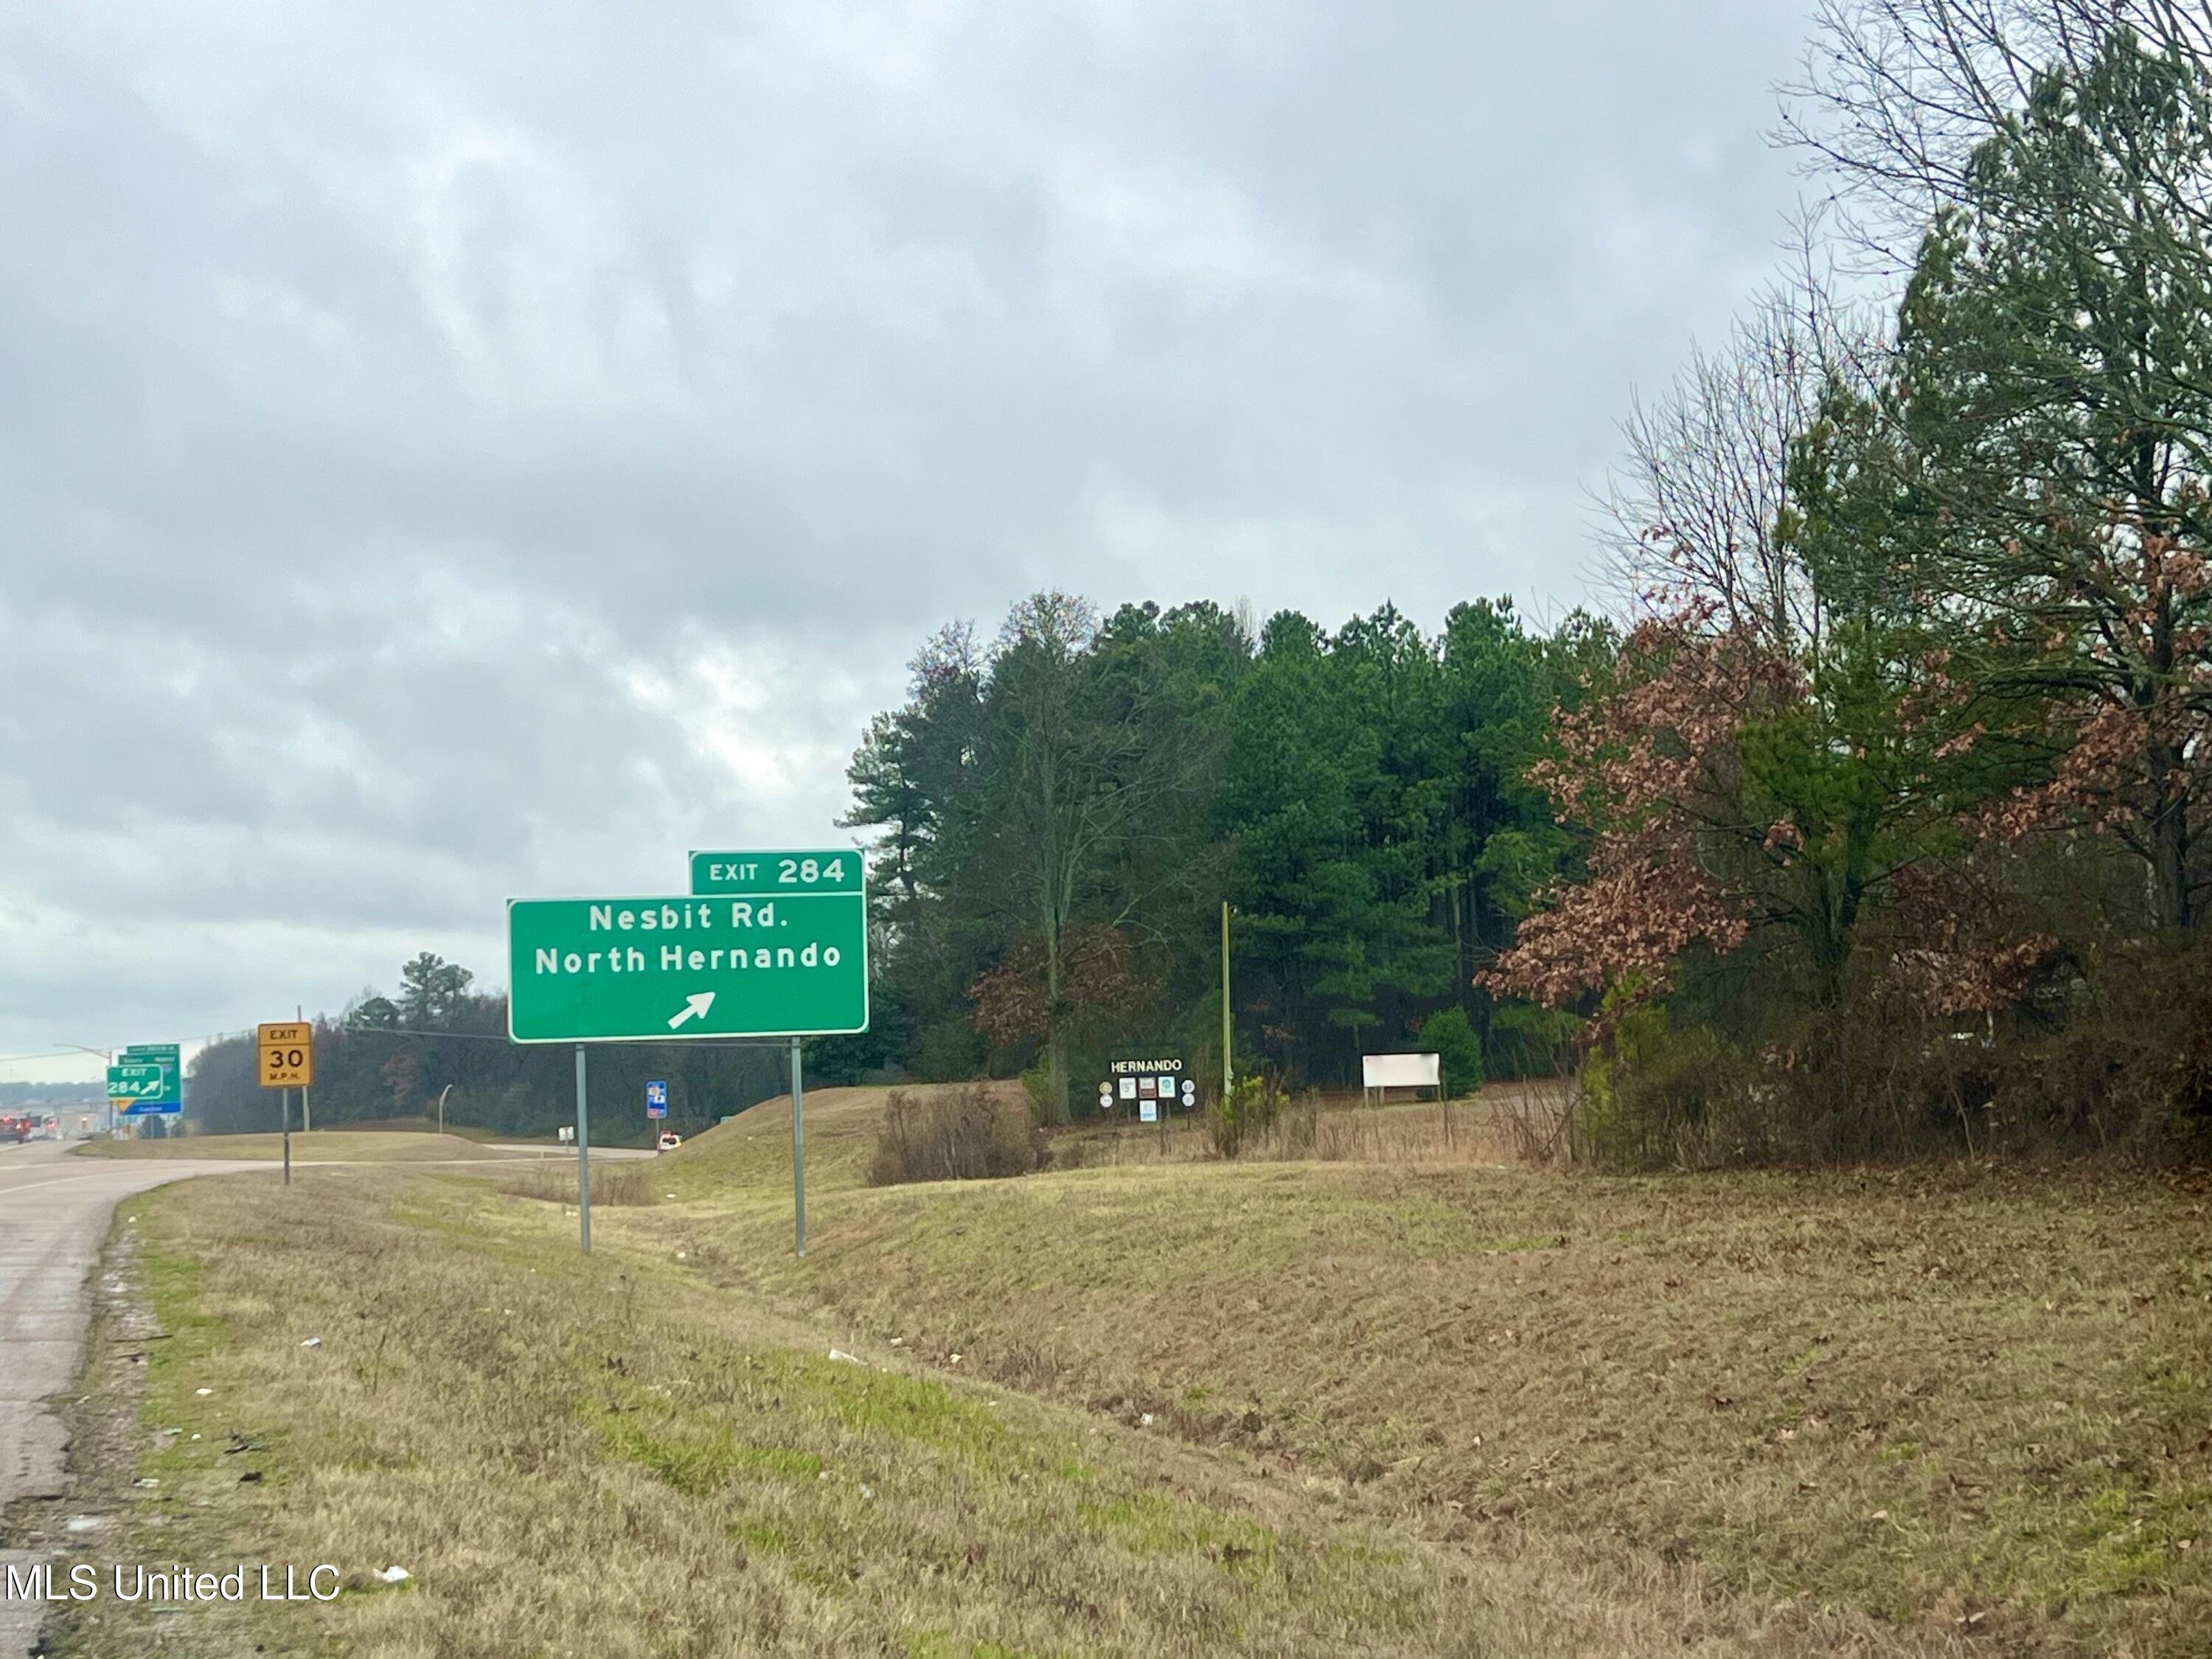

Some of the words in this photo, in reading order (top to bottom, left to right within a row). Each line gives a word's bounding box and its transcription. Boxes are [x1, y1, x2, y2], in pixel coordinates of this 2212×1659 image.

[710, 863, 758, 881] EXIT
[778, 859, 844, 883] 284
[589, 904, 712, 931] Nesbit
[731, 902, 788, 928] Rd.
[535, 947, 645, 974] North
[661, 942, 841, 971] Hernando
[269, 1029, 299, 1040] EXIT
[269, 1049, 303, 1068] 30
[122, 1068, 147, 1077] EXIT
[1111, 1059, 1183, 1073] HERNANDO
[269, 1072, 302, 1082] M.P.H.
[108, 1081, 140, 1093] 284
